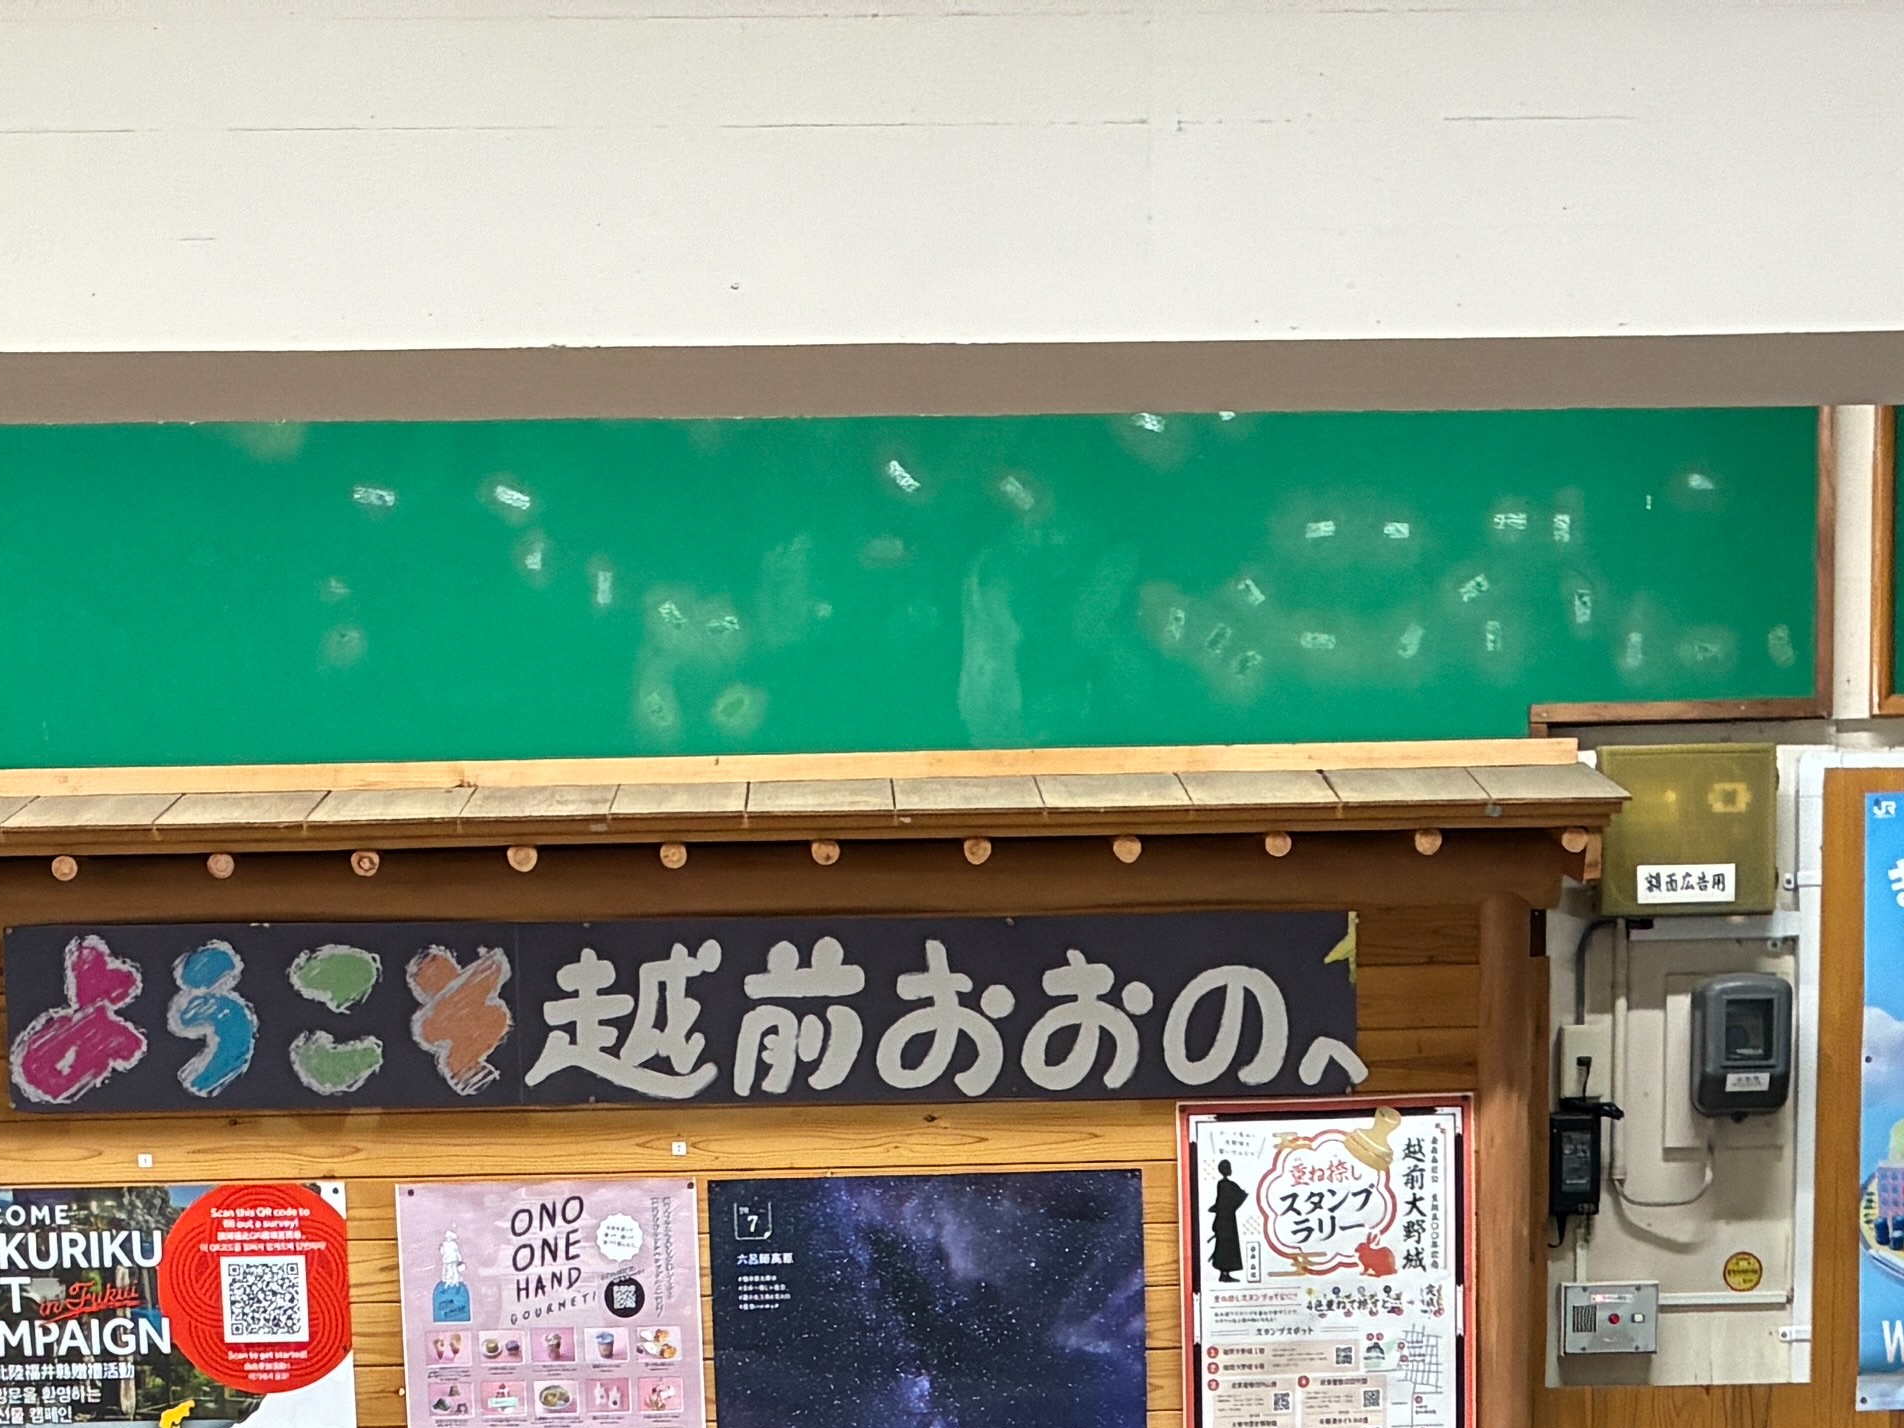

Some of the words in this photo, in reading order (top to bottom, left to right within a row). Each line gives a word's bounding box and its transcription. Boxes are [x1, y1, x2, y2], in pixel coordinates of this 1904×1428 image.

[1875, 800, 1896, 816] JR
[10, 933, 516, 1105] ようこそ
[524, 936, 1370, 1099] 越前おおのへ
[210, 1208, 235, 1218] Scan
[236, 1208, 255, 1217] this
[256, 1207, 272, 1217] QR
[273, 1207, 297, 1217] code
[298, 1208, 310, 1217] to
[1279, 1183, 1376, 1217] スタンプ
[1401, 1136, 1428, 1273] 越前大野城
[511, 1196, 585, 1237] ONO
[747, 1215, 758, 1233] 7
[1291, 1215, 1366, 1244] ラリー
[512, 1228, 582, 1272] ONE
[737, 1252, 794, 1266] 六呂師高原
[68, 1280, 139, 1309] Fukui
[516, 1267, 582, 1303] HAND
[228, 1350, 248, 1360] Scan
